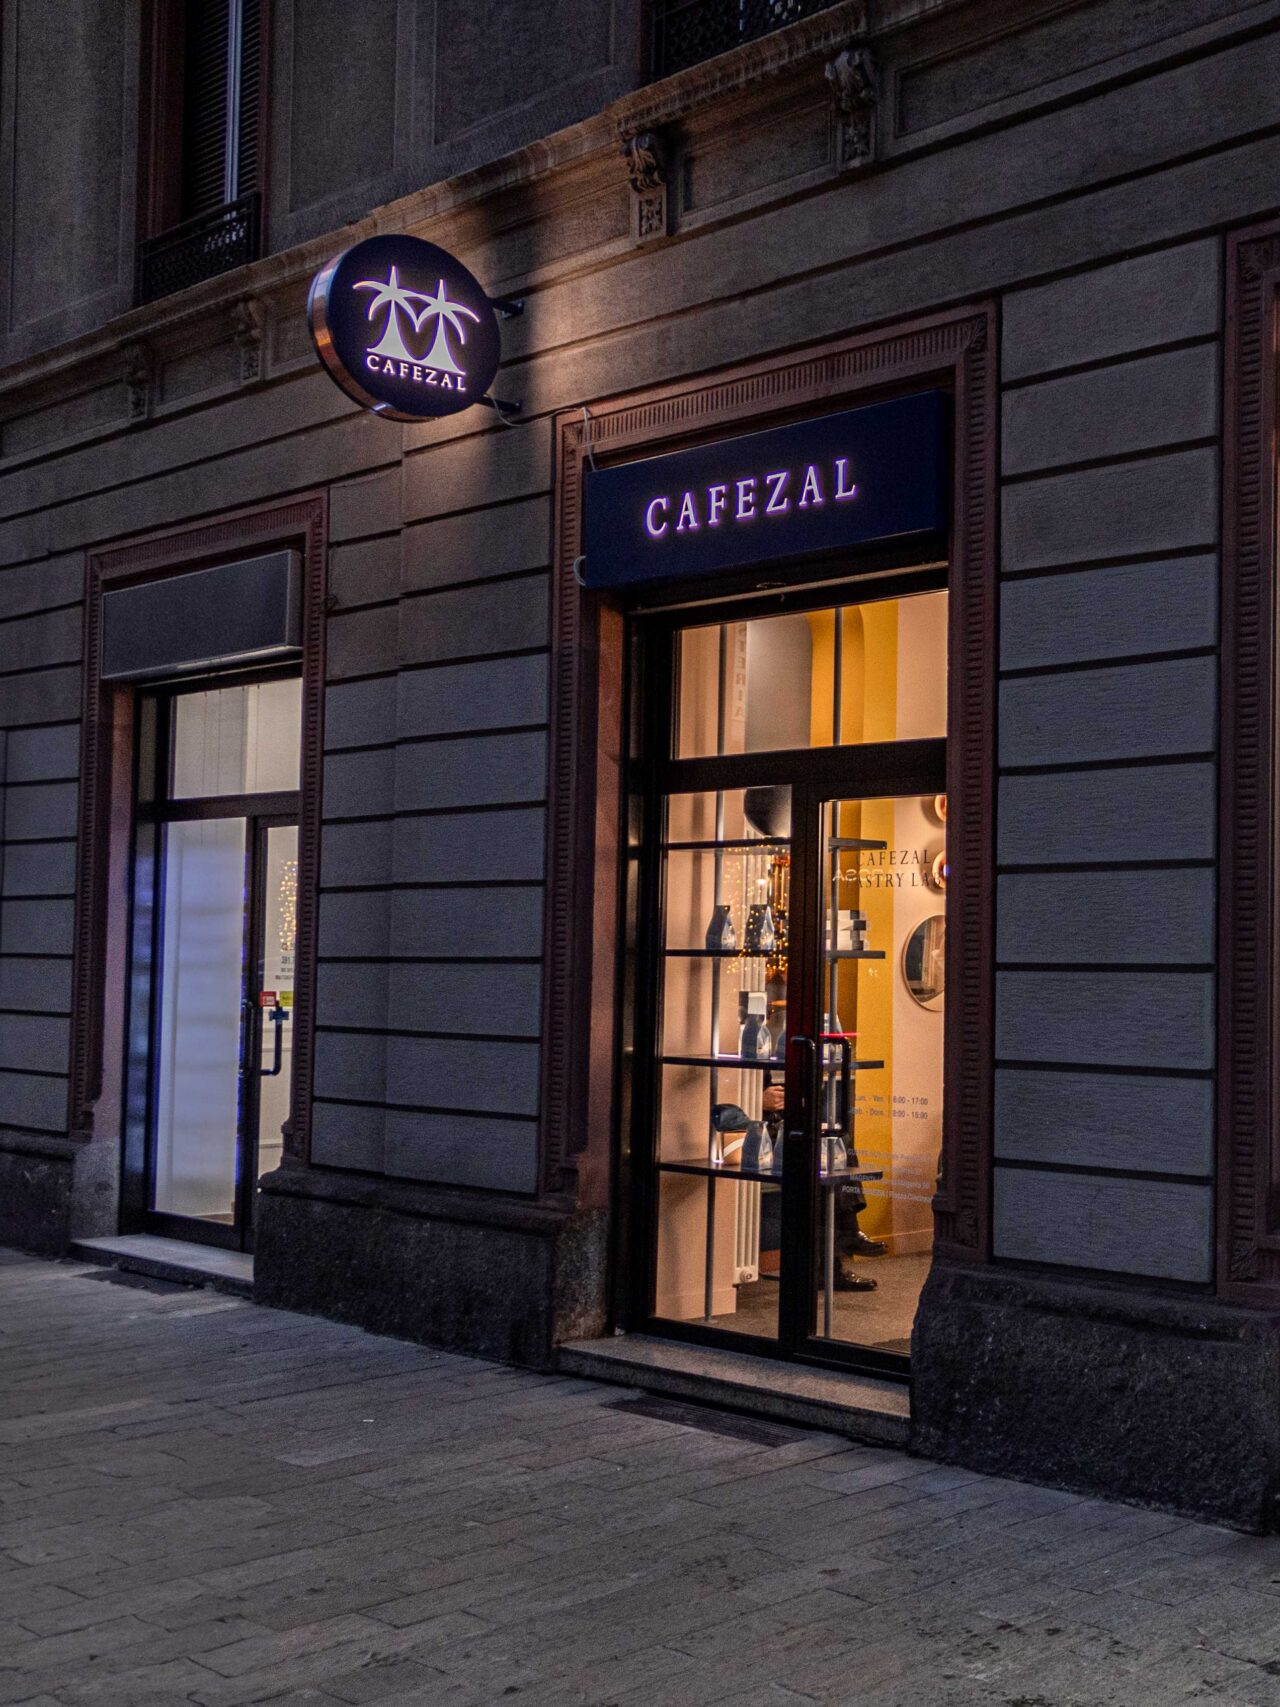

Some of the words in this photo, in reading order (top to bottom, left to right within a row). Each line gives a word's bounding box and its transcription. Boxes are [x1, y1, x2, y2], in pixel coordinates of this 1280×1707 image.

[366, 355, 466, 391] CAFEZAL
[647, 459, 856, 535] CAFEZAL
[856, 849, 932, 867] CAFEZAL
[846, 873, 904, 889] ASTRY
